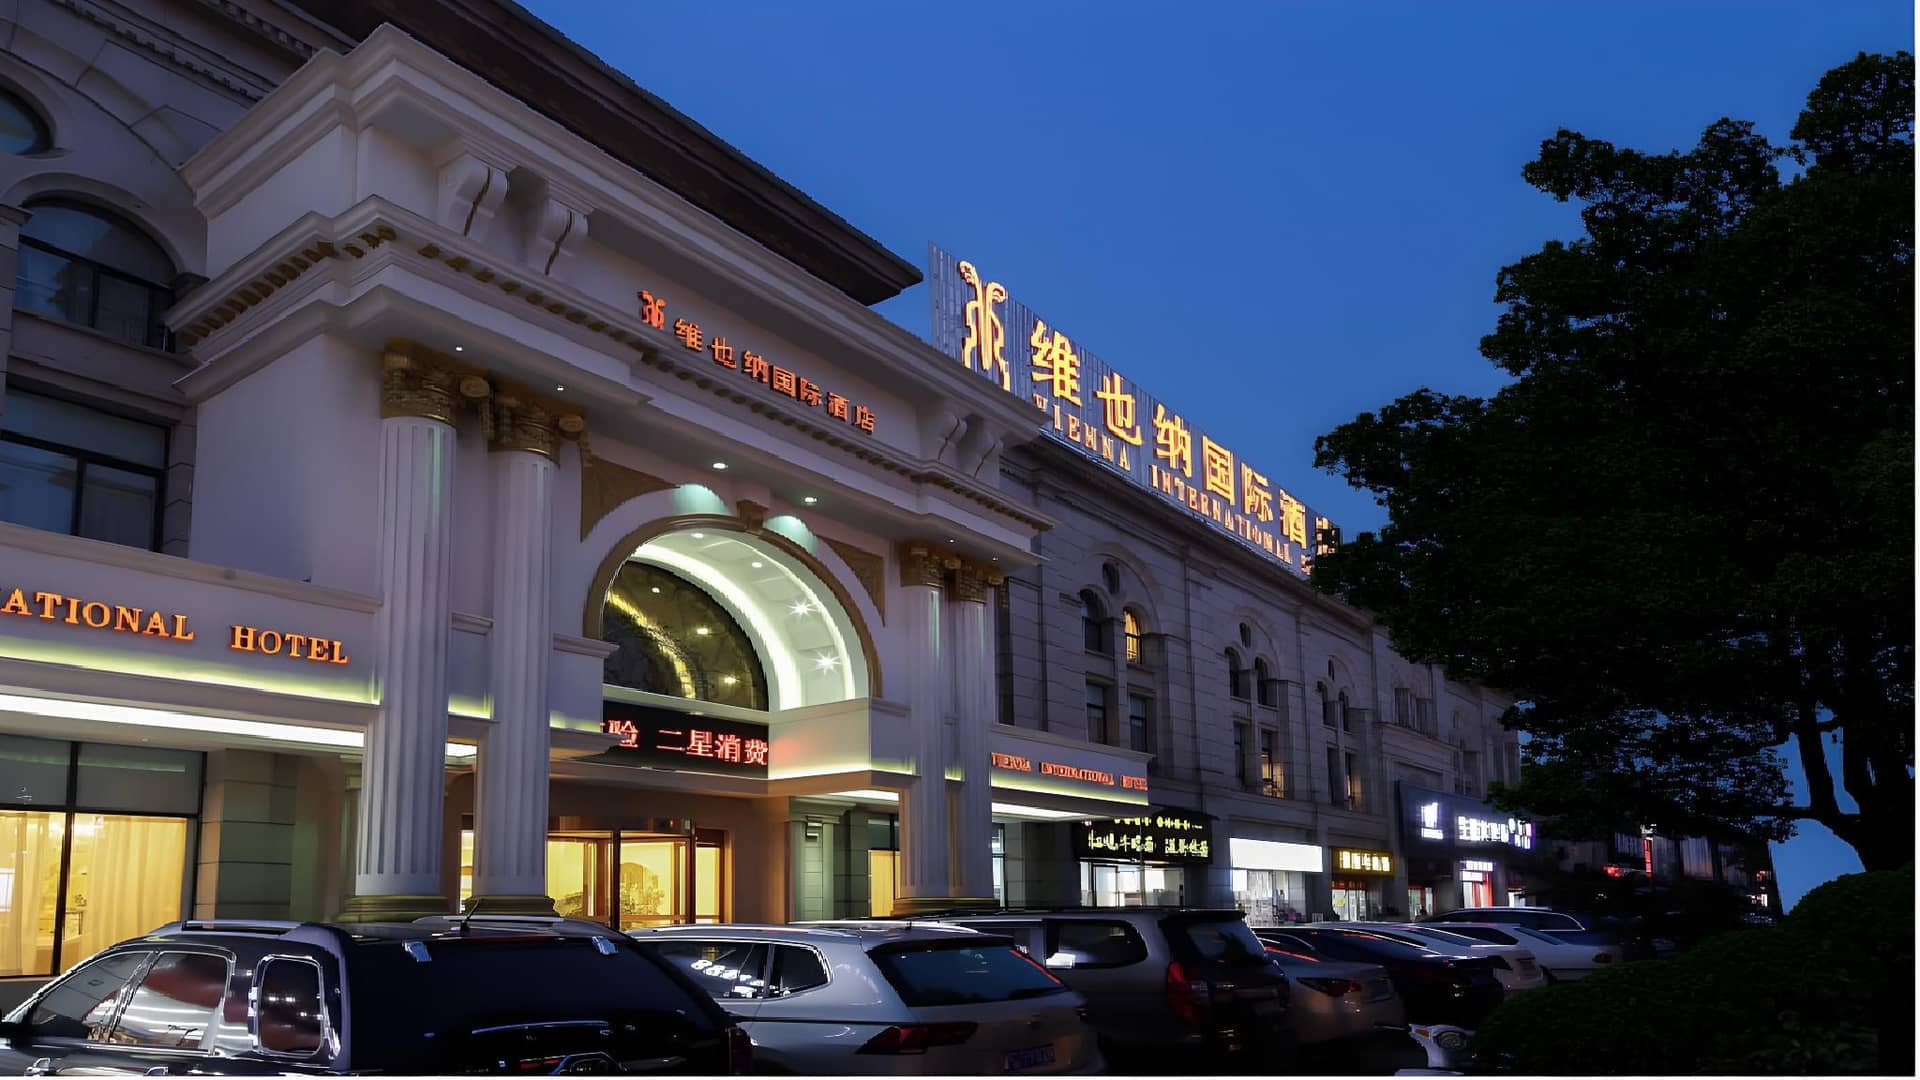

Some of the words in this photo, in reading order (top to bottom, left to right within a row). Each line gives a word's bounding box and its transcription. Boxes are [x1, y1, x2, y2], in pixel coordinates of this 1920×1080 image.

[674, 317, 876, 433] 维也纳国际酒店
[1149, 463, 1293, 565] INTERNATIONAL
[0, 586, 195, 642] ATIONAL
[230, 624, 349, 664] HOTEL
[656, 728, 769, 766] 二星消费
